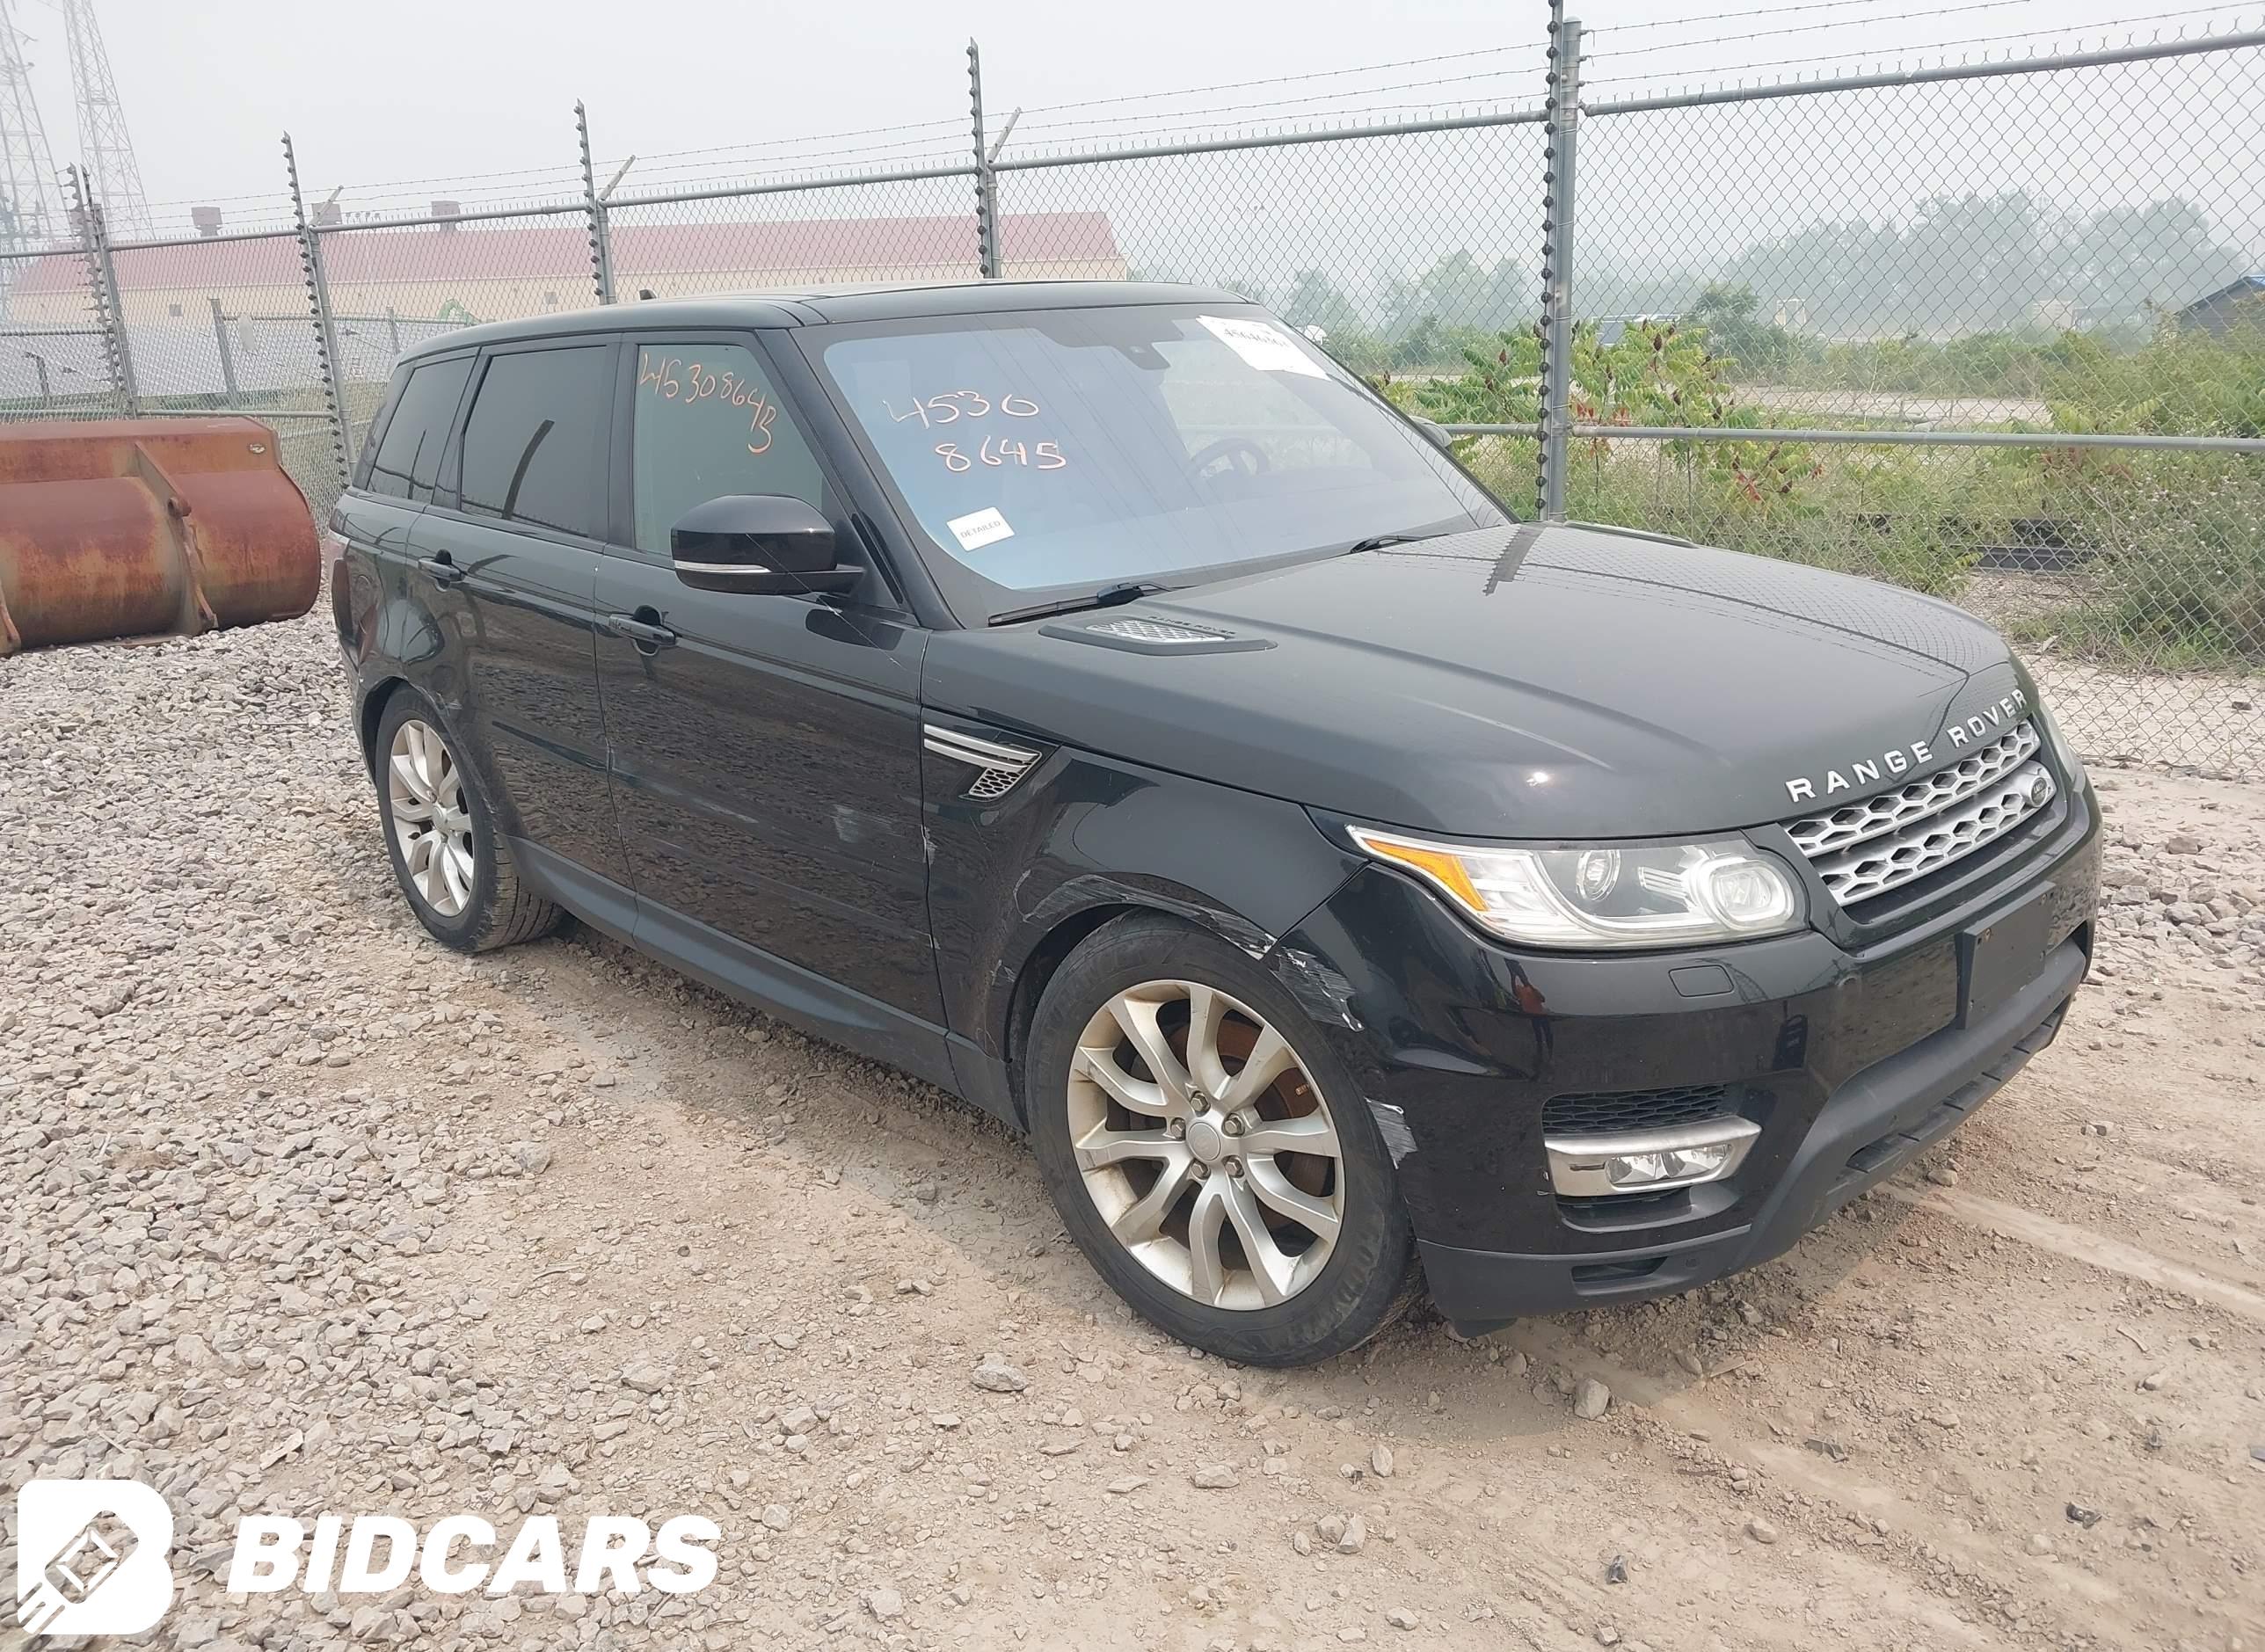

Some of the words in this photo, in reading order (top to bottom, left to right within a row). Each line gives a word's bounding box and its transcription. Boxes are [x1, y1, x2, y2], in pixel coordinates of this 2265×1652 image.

[882, 389, 1039, 430] 4530
[935, 435, 1067, 472] 8645
[959, 520, 1001, 539] DETAILED
[1785, 740, 1934, 803] RANGE
[1947, 688, 2028, 748] ROVER
